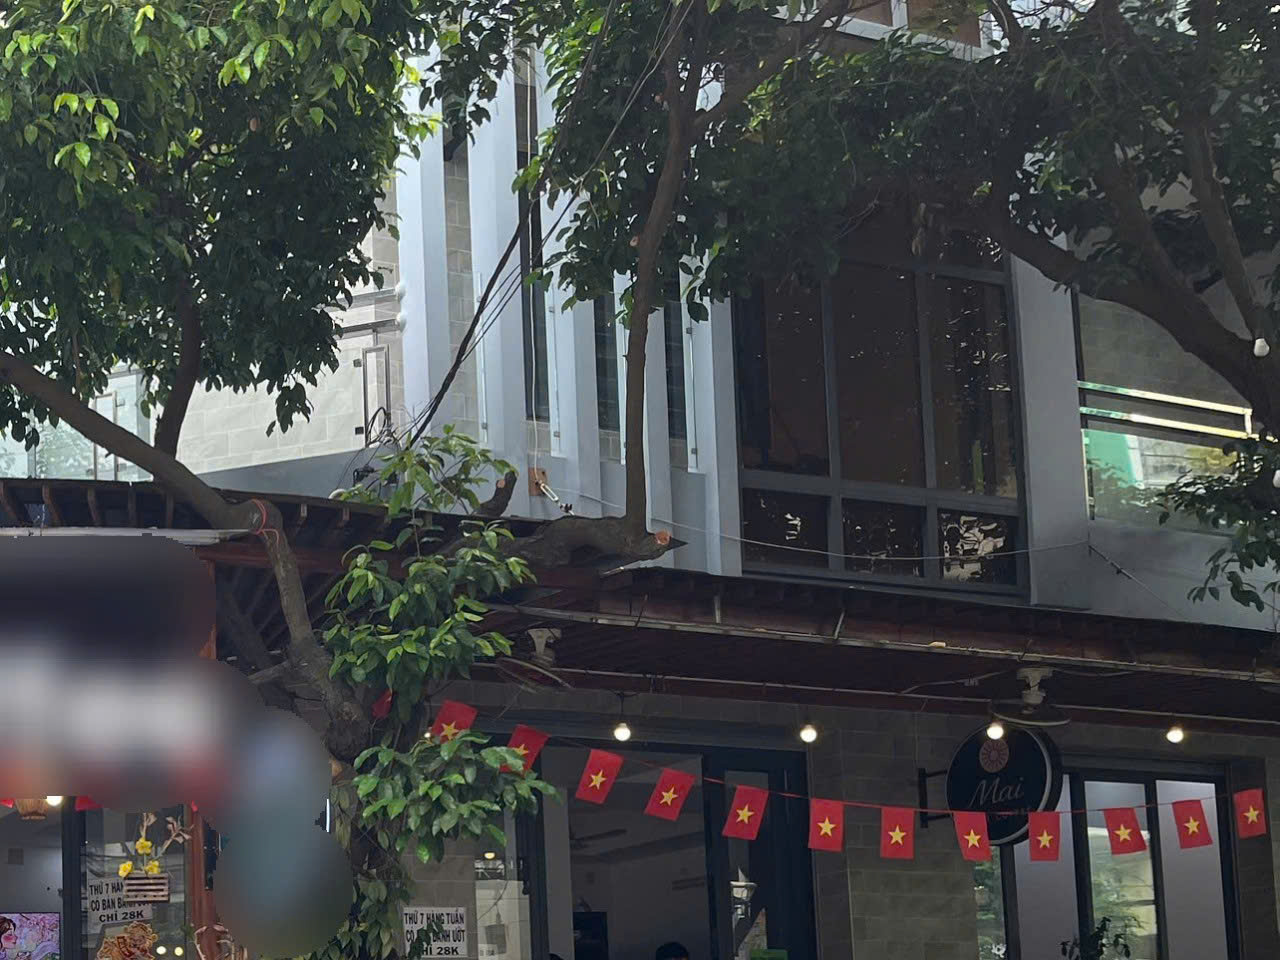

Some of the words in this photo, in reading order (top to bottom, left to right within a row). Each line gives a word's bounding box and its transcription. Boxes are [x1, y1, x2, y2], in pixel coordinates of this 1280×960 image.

[969, 777, 1024, 808] Mai
[122, 909, 144, 920] 28K
[420, 912, 425, 924] 7
[437, 946, 459, 956] 28K
